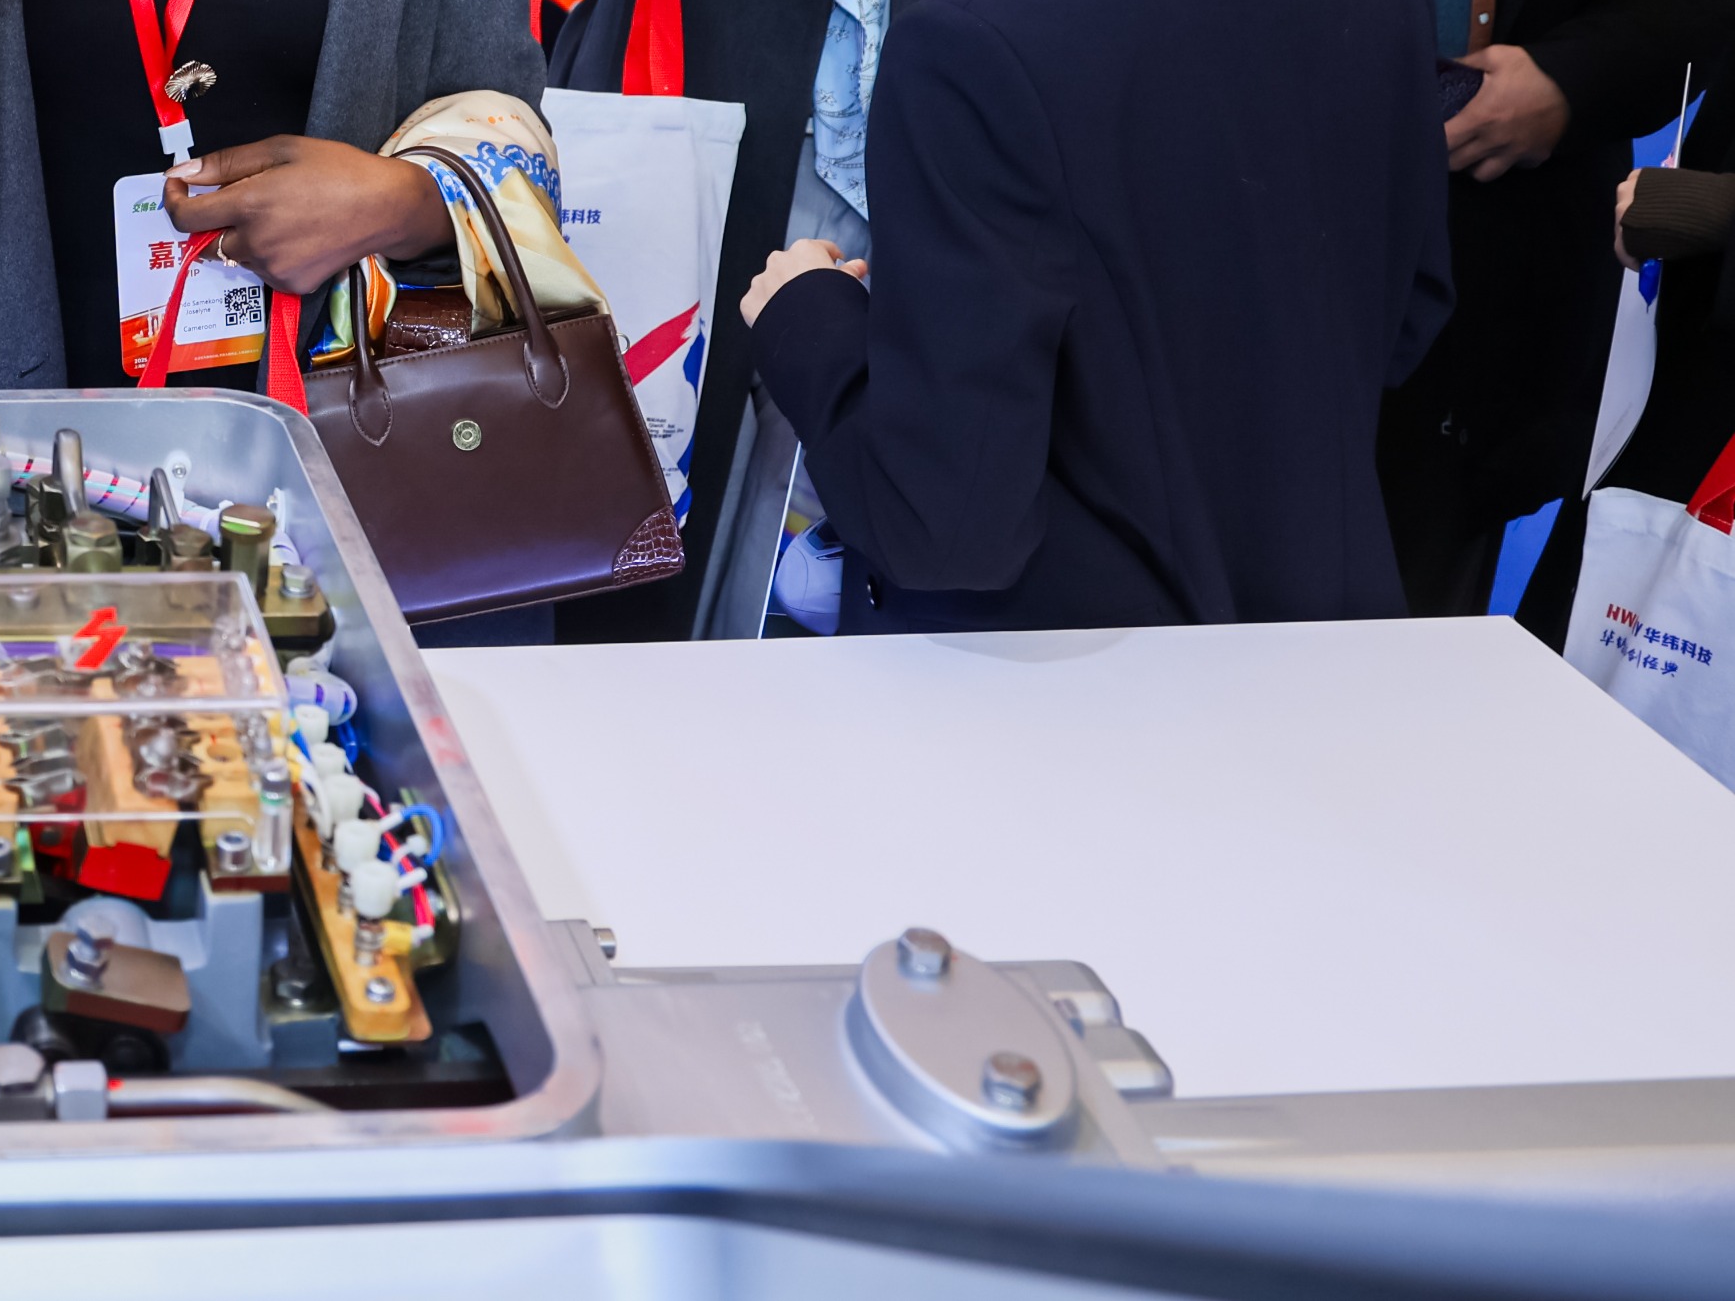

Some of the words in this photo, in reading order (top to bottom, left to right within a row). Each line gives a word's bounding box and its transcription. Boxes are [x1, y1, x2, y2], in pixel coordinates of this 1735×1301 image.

[183, 323, 217, 334] Cameroon
[1643, 627, 1713, 667] 华纬科技
